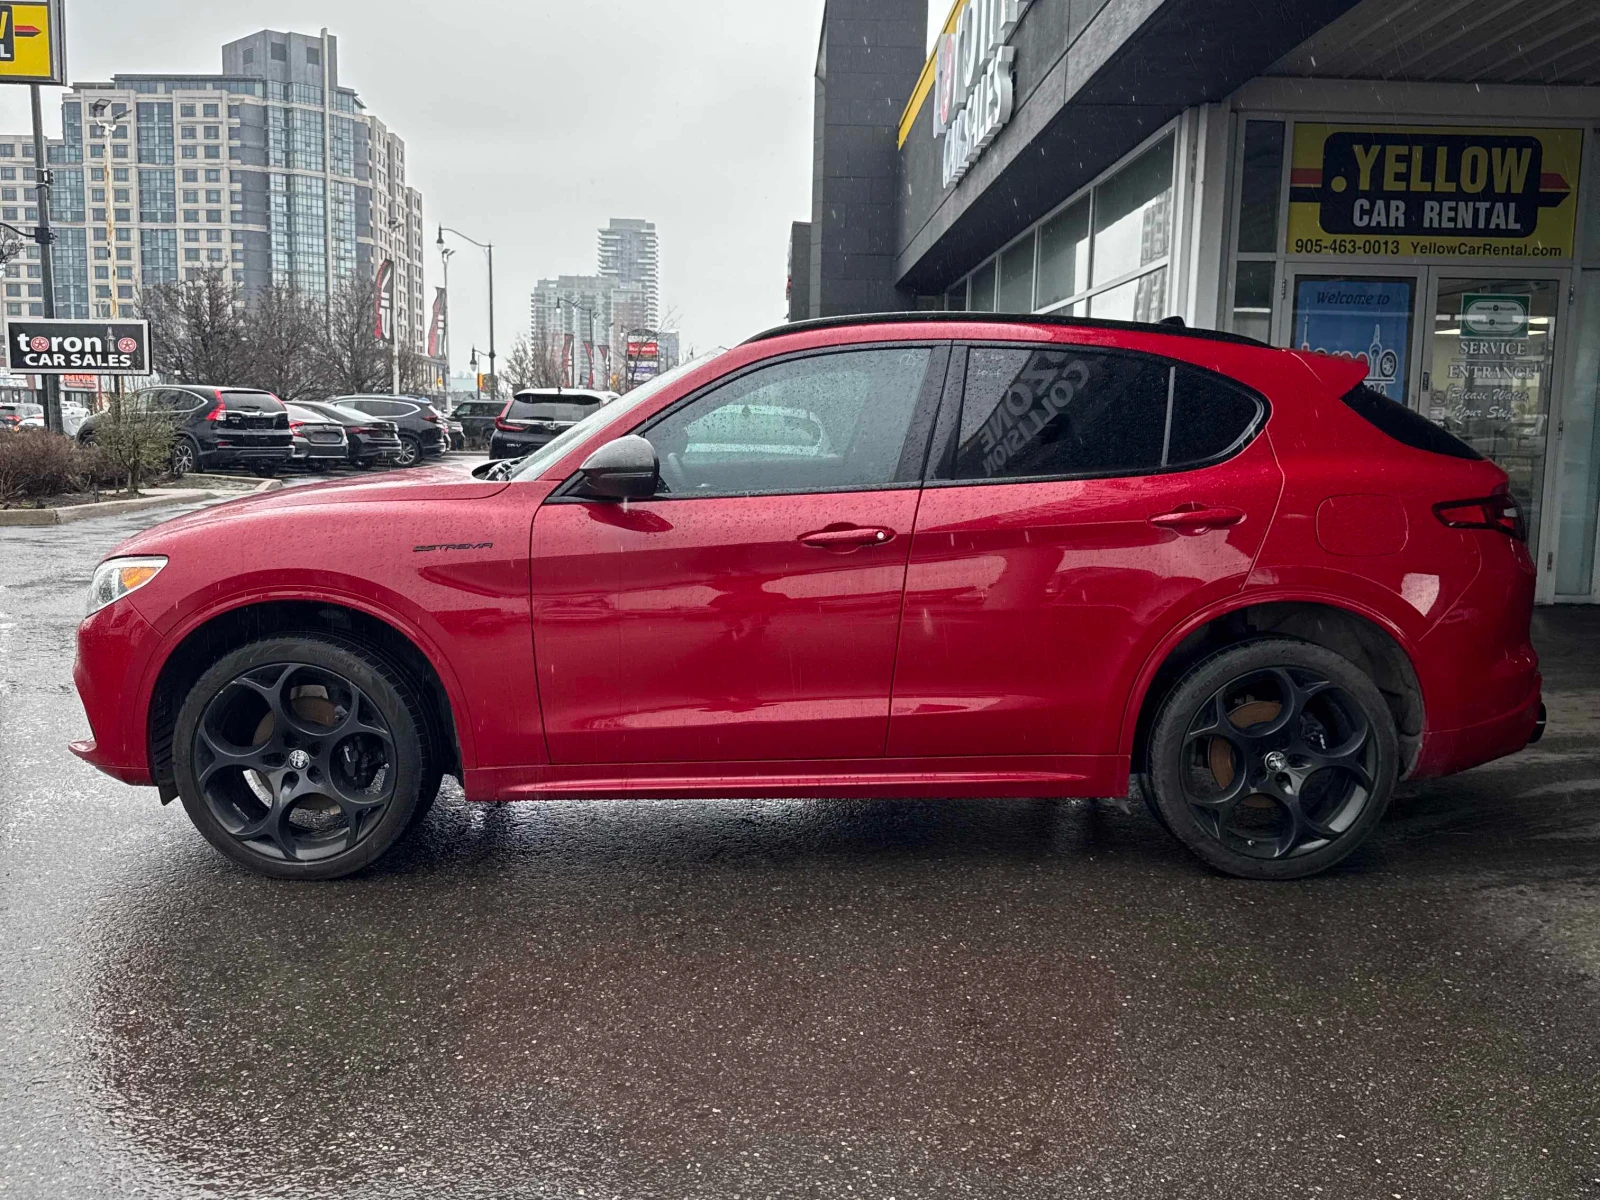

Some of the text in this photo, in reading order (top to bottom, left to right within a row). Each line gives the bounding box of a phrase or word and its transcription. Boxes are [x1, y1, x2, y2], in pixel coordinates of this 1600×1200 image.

[1352, 144, 1532, 194] YELLOW
[1353, 198, 1521, 231] CAR RENTAL
[1294, 238, 1563, 258] 905-463-0013 YellowCarRental.com
[1316, 291, 1391, 306] Welcome to
[1460, 341, 1527, 355] SERVICE
[25, 353, 131, 367] CAR SALES
[1448, 365, 1536, 378] ENTRANCE
[1451, 387, 1529, 400] Please Watch
[1455, 405, 1482, 420] Your
[1486, 406, 1514, 420] Step
